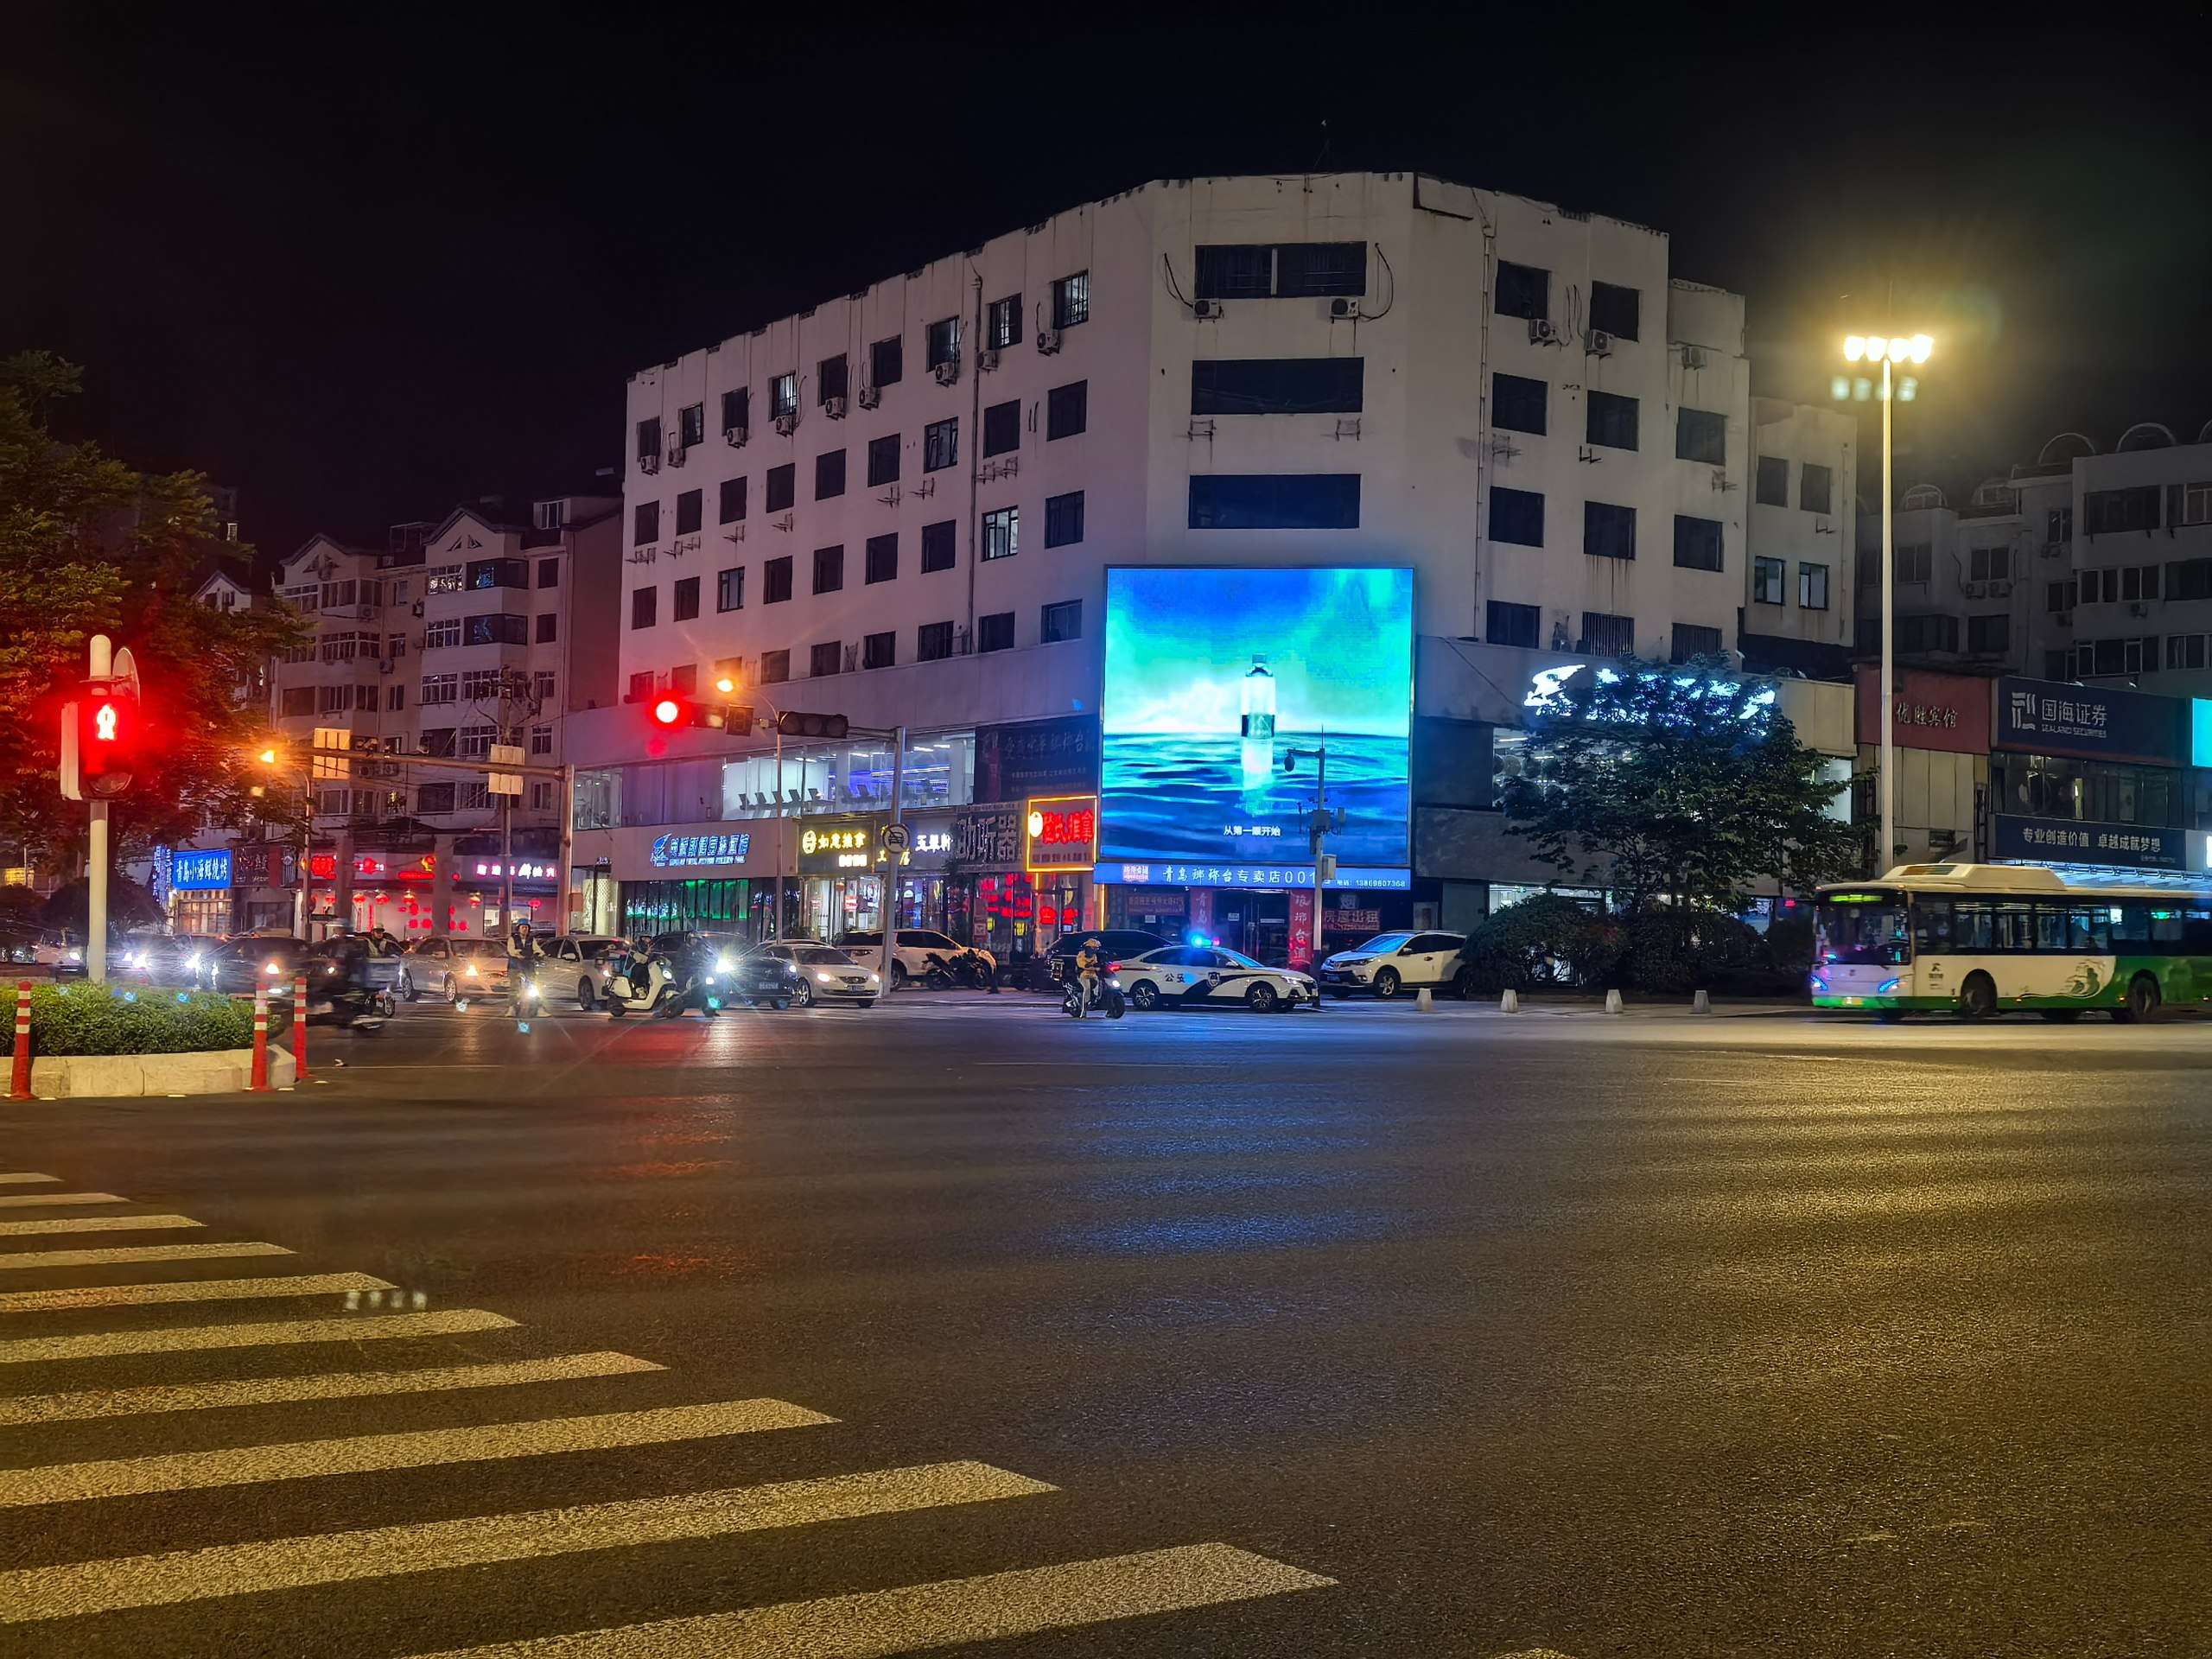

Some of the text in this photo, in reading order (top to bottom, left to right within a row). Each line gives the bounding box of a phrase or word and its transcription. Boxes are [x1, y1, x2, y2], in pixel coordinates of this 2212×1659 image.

[1896, 702, 1958, 728] 优胜宾馆
[2042, 699, 2108, 727] 国海证券
[1223, 824, 1281, 837] 从第一眼开始
[2022, 826, 2161, 854] 专业创造价值 卓越成就梦想
[1324, 908, 1380, 924] 房屋出租
[1164, 972, 1186, 983] 公安
